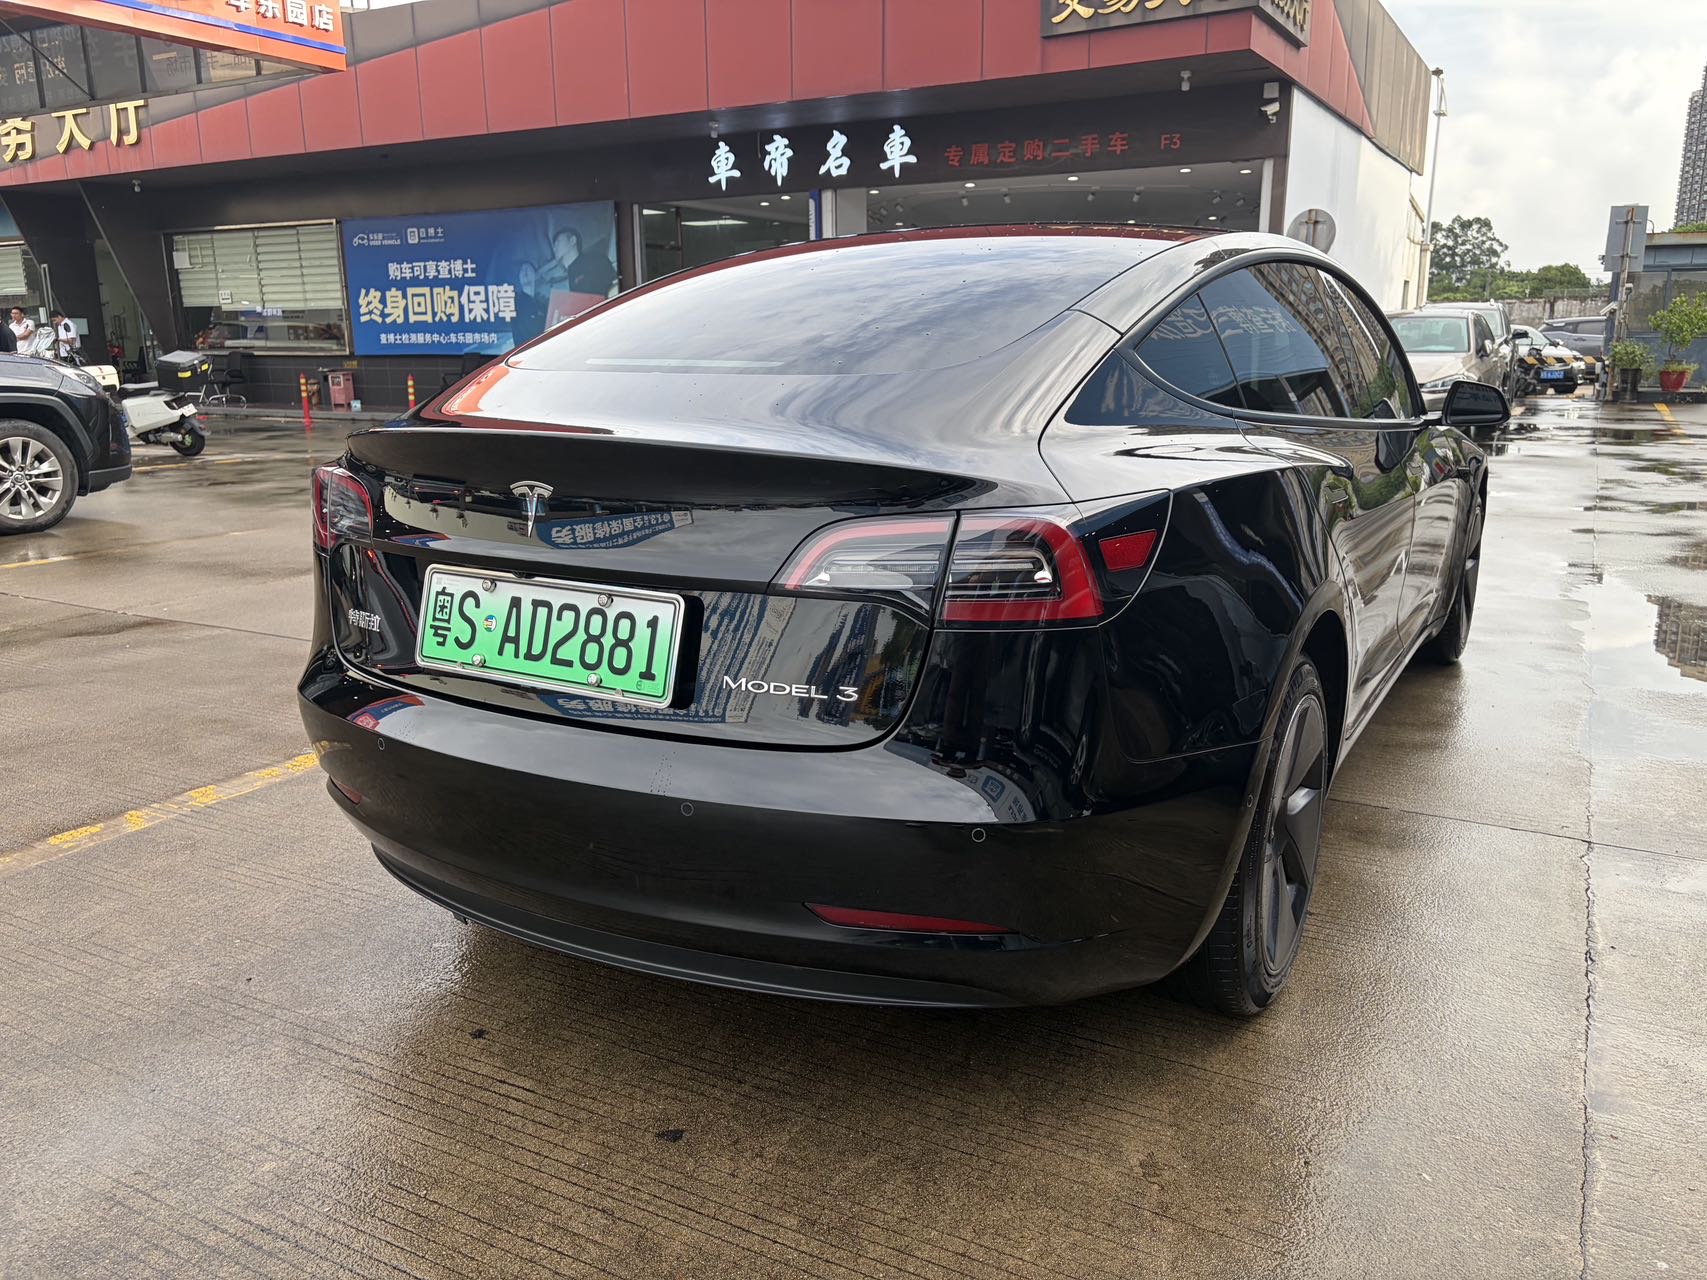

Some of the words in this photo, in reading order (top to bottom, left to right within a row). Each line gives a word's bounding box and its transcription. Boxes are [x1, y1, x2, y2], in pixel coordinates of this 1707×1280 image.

[0, 99, 146, 162] 务大厅
[944, 132, 1129, 167] 专属定购二手车
[1160, 134, 1182, 150] F3
[708, 124, 918, 191] 車帝名車
[388, 259, 477, 280] 购车可享查博士
[359, 283, 517, 324] 终身回购保障
[723, 675, 828, 699] MODEL
[836, 686, 859, 702] 3
